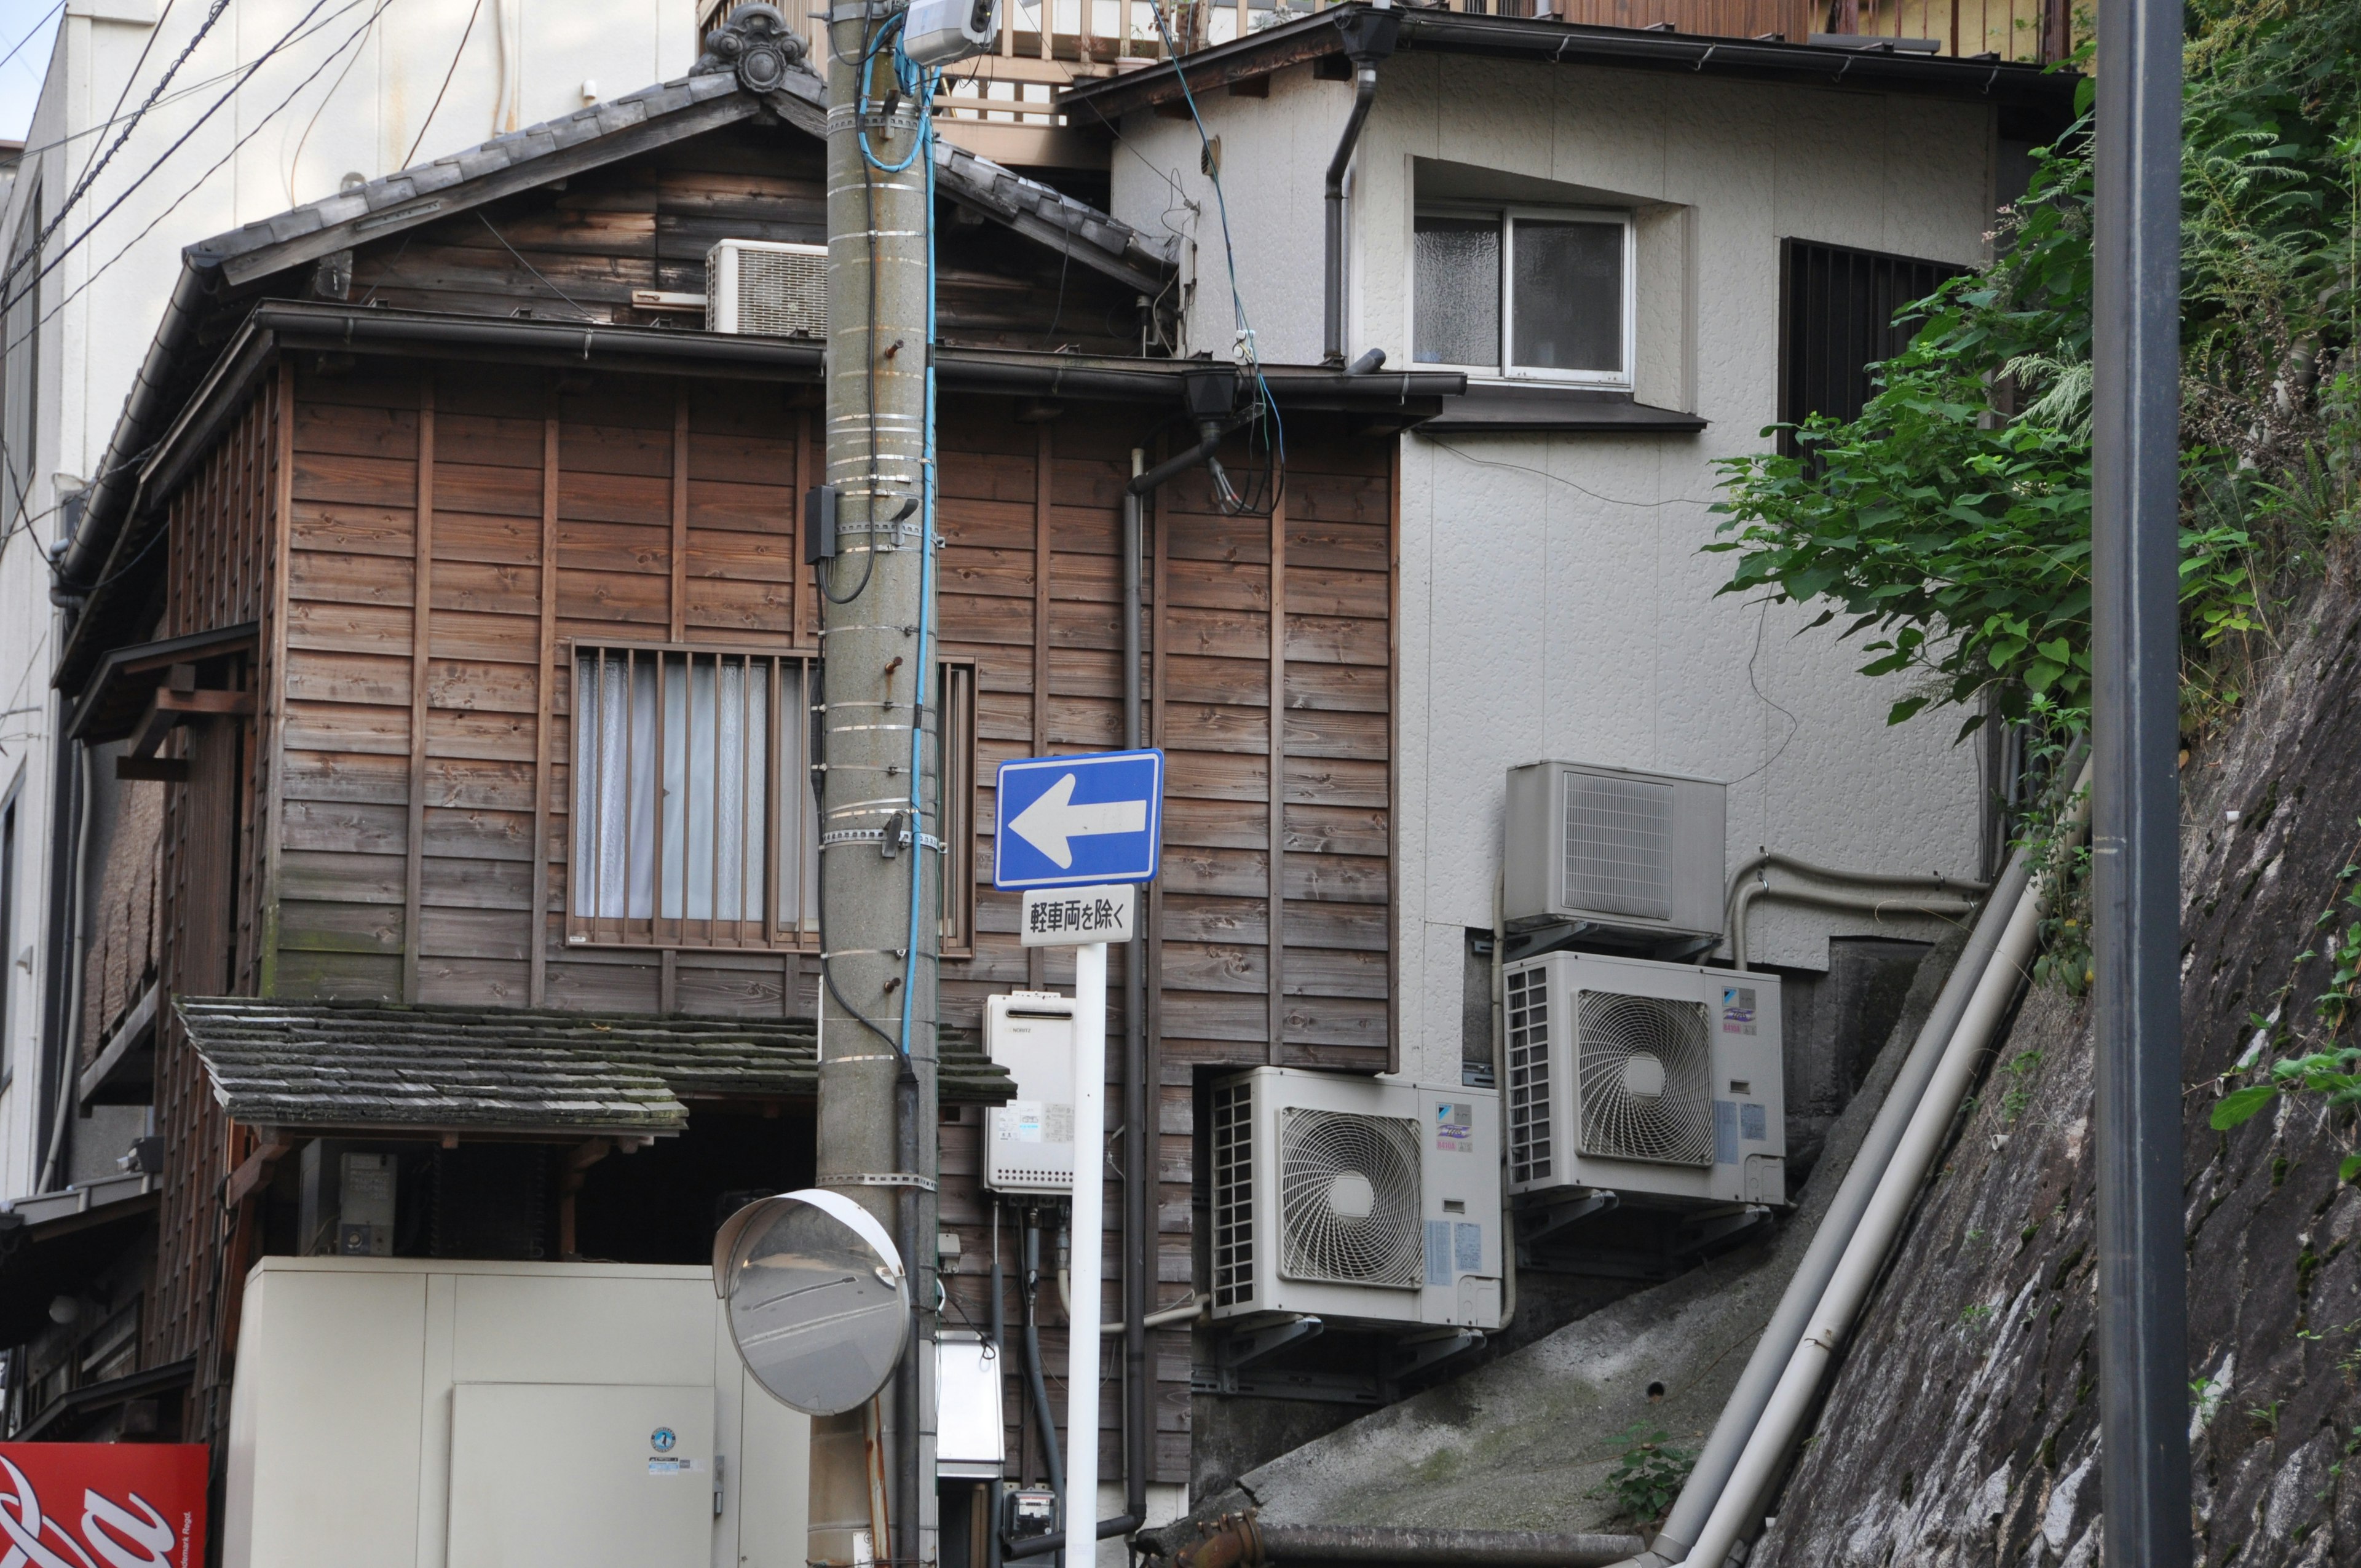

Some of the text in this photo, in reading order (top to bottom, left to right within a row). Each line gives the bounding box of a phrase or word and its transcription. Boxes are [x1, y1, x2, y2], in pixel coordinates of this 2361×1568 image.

[1030, 899, 1124, 933] 軽車両を除く
